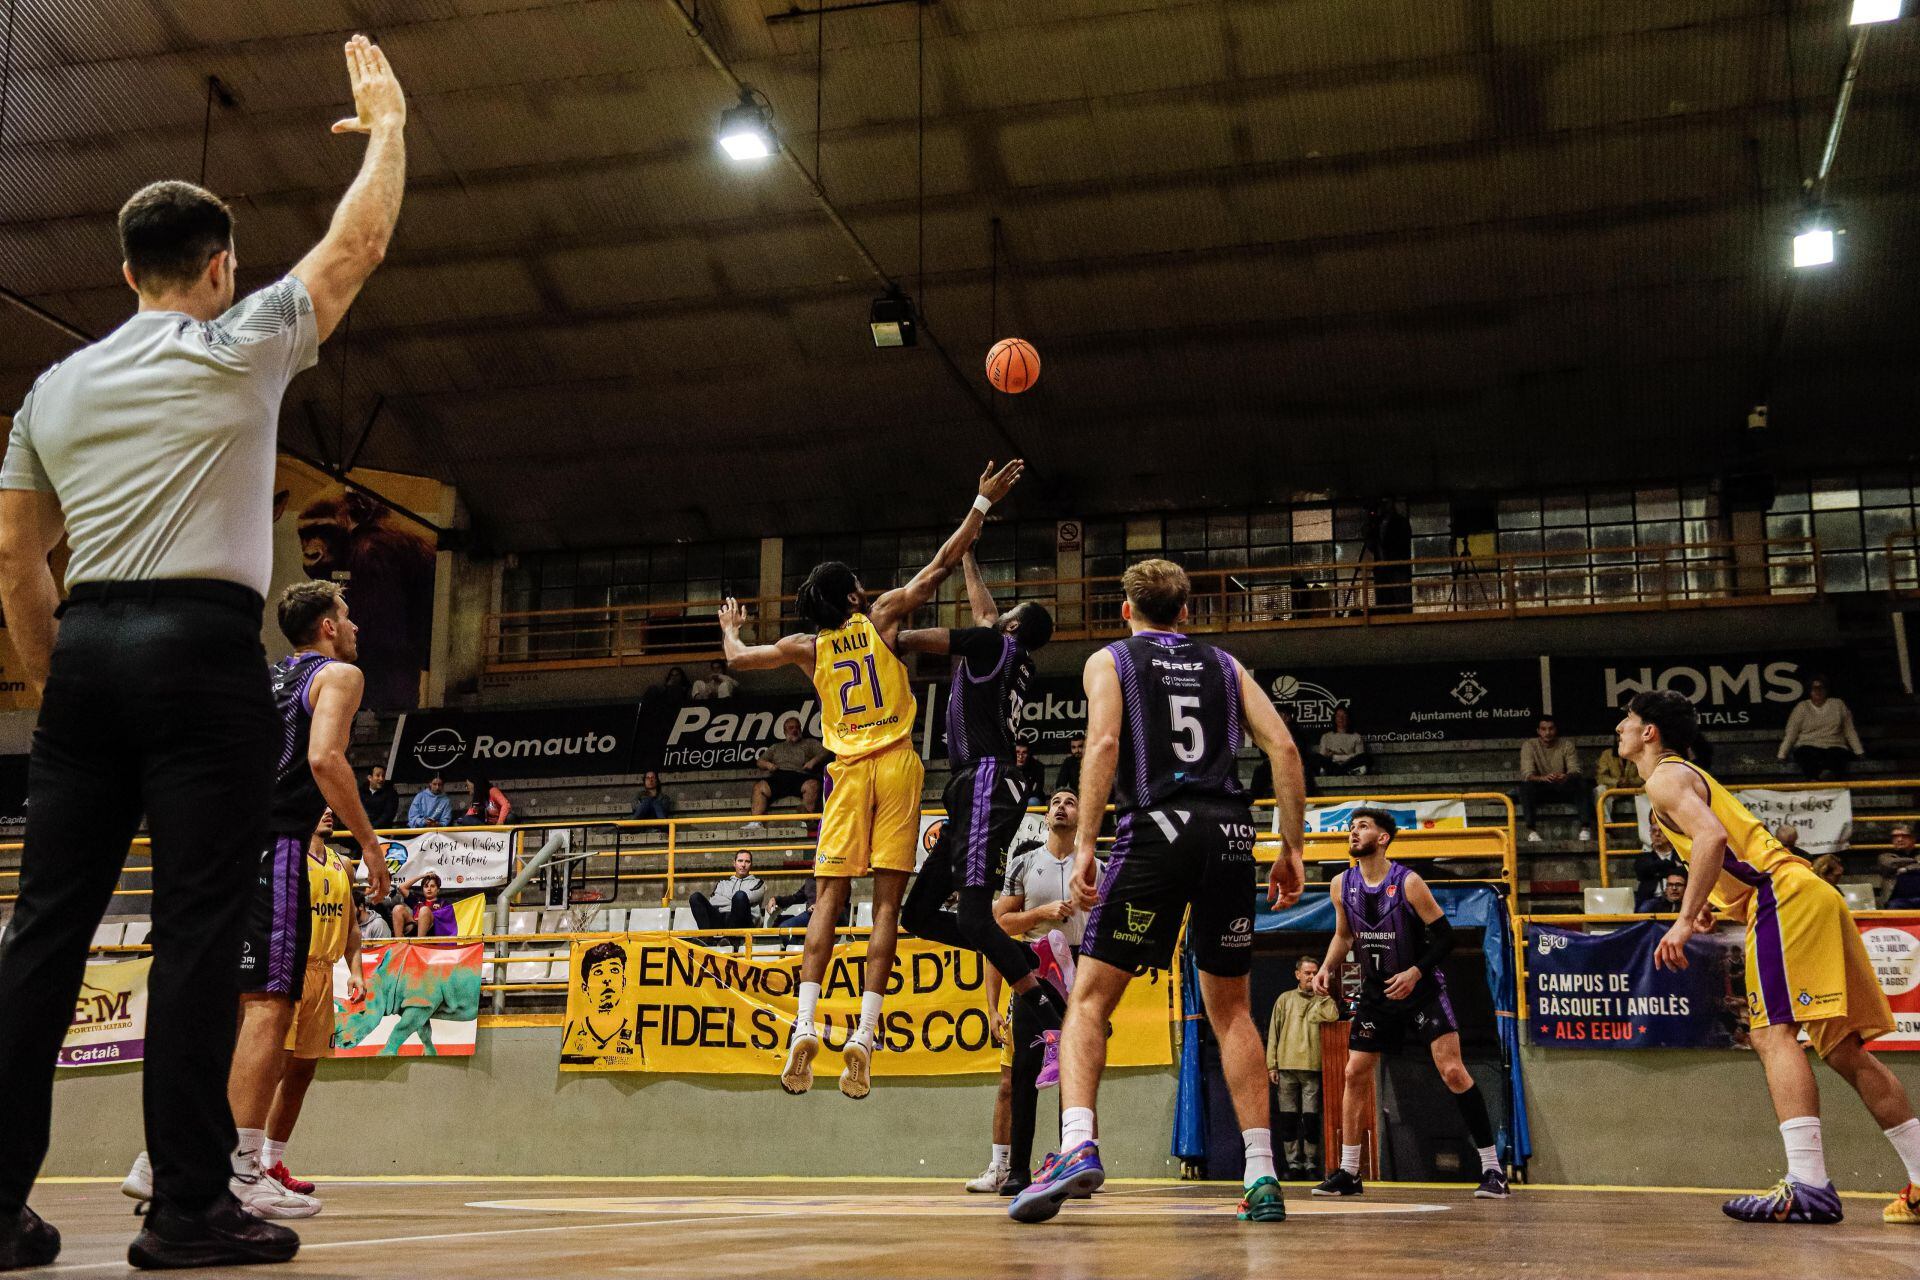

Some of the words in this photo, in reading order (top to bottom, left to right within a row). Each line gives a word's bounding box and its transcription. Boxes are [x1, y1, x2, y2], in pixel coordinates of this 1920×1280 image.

[832, 632, 869, 654] KALU
[1151, 658, 1204, 671] PÉREZ
[833, 653, 884, 716] 21
[1604, 661, 1804, 708] HOMS
[1409, 710, 1472, 722] Ajuntament
[1475, 709, 1489, 718] de
[1492, 707, 1531, 718] Mataró
[1168, 695, 1205, 763] 5
[413, 743, 467, 753] NISSAN
[472, 731, 617, 759] Romauto
[1112, 929, 1143, 945] family
[1371, 953, 1380, 971] 7
[639, 947, 905, 1000] ENAMOATS
[1538, 973, 1604, 993] CAMPUS
[1609, 973, 1630, 993] DE
[1539, 994, 1612, 1017] BÀSQUET
[1615, 998, 1623, 1016] I
[1627, 993, 1690, 1016] ANGLÈS
[634, 1003, 779, 1051] FIDELS
[1555, 1021, 1586, 1040] ALS
[1591, 1021, 1633, 1041] EEUU
[70, 1044, 120, 1061] Català
